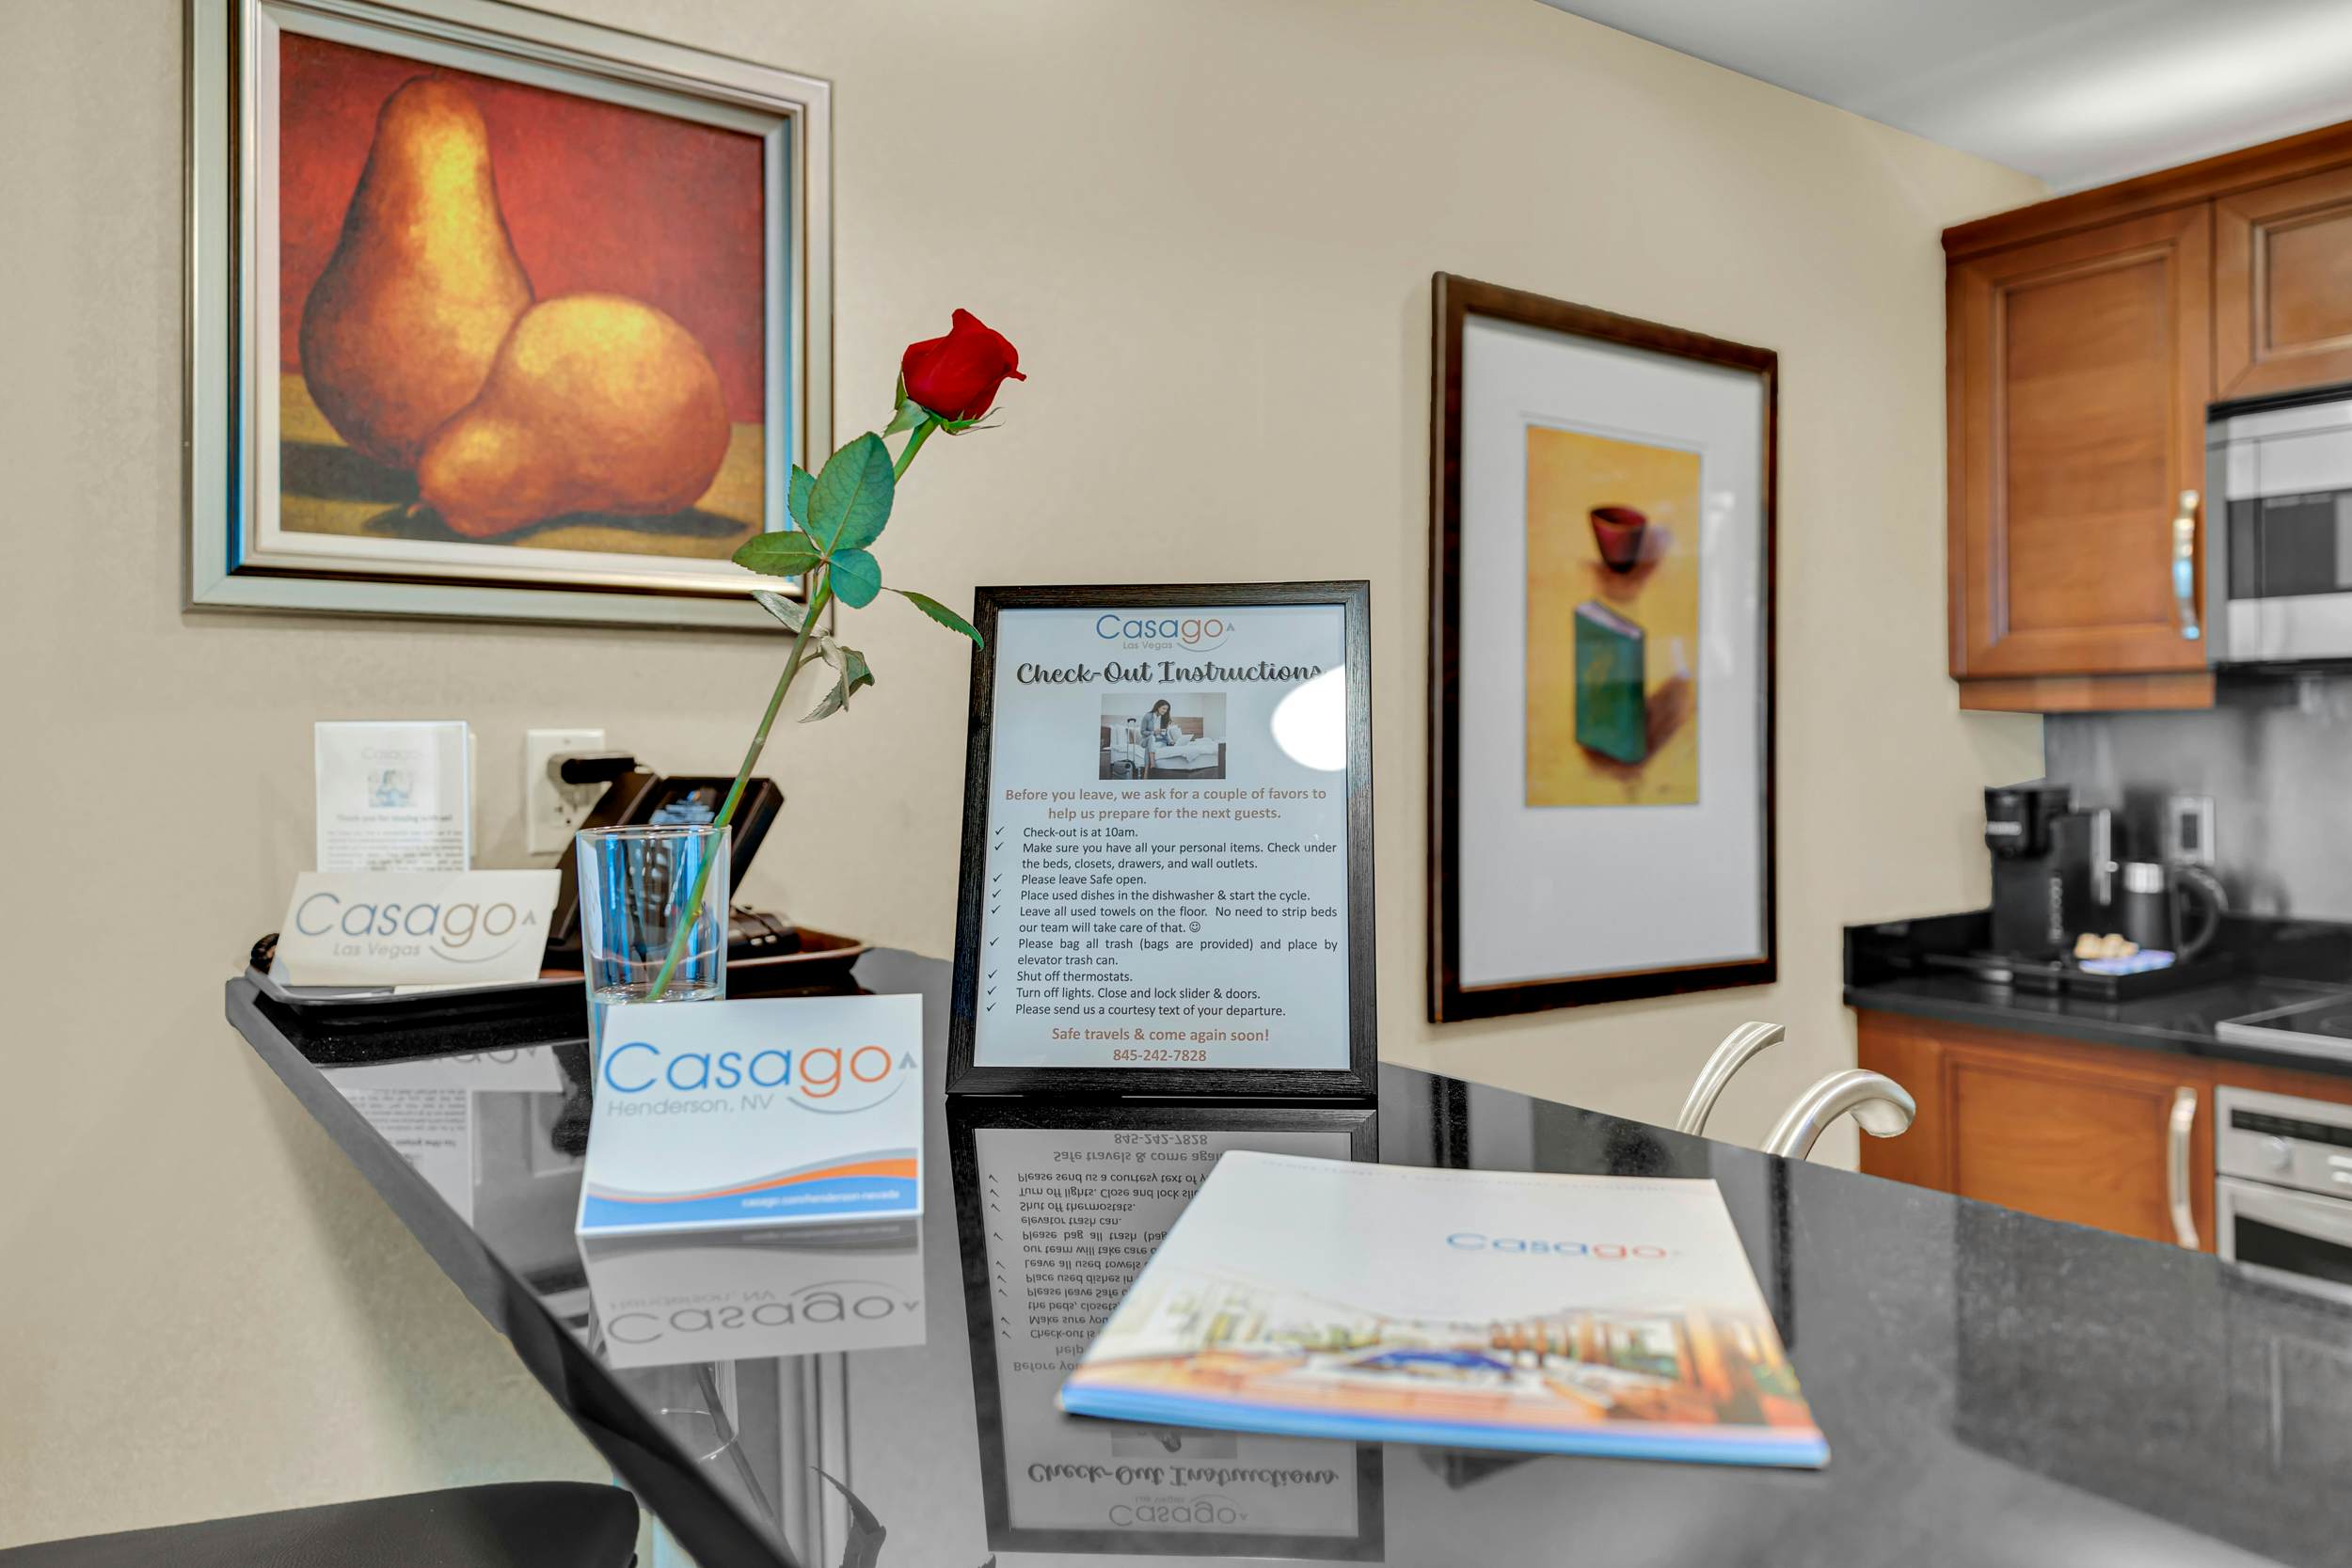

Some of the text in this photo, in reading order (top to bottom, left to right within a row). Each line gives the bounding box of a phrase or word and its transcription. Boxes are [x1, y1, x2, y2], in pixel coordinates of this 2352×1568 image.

[1096, 614, 1223, 643] Casago
[1122, 641, 1173, 652] Las Vegas
[1017, 662, 1152, 684] Check-Out
[1006, 787, 1327, 802] Before you leave, we ask for a couple of favors to
[1048, 807, 1281, 822] help us prepare for the next guests.
[1024, 827, 1138, 837] Check-out is at 10am.
[1023, 842, 1337, 855] Make sure you have all your personal items. Check under
[1022, 858, 1258, 871] the beds, closets, drawers, and wall outlets.
[1022, 873, 1146, 887] Please leave Safe open.
[1021, 890, 1311, 903] Place used dishes in the dishwasher & start the cycle.
[1020, 907, 1051, 916] Leave
[1054, 906, 1067, 916] all
[1071, 906, 1097, 917] used
[1100, 906, 1136, 917] towels
[1157, 906, 1176, 917] the
[1180, 905, 1207, 917] floor.
[1216, 907, 1232, 916] No
[1234, 906, 1263, 917] need
[1266, 908, 1279, 917] to
[1281, 906, 1308, 919] strip
[1311, 906, 1338, 917] beds
[295, 893, 516, 948] Casago
[1019, 922, 1185, 933] our team will take care of that.
[332, 942, 421, 959] Las Vegas
[1018, 938, 1338, 952] Please bag all trash (bags are provided) and place by
[1018, 954, 1118, 965] elevator trash can.
[1017, 971, 1133, 982] Shut off thermostats.
[1016, 987, 1261, 1001] Turn off lights. Close and lock slider & doors.
[1016, 1004, 1286, 1018] Please send us a courtesy text of your departure.
[1052, 1027, 1268, 1044] Safe travels & come again soon!
[1113, 1049, 1207, 1062] 845-242-7828
[604, 1041, 893, 1099] Casago
[740, 1092, 774, 1111] NV
[1446, 1233, 1666, 1259] Casago
